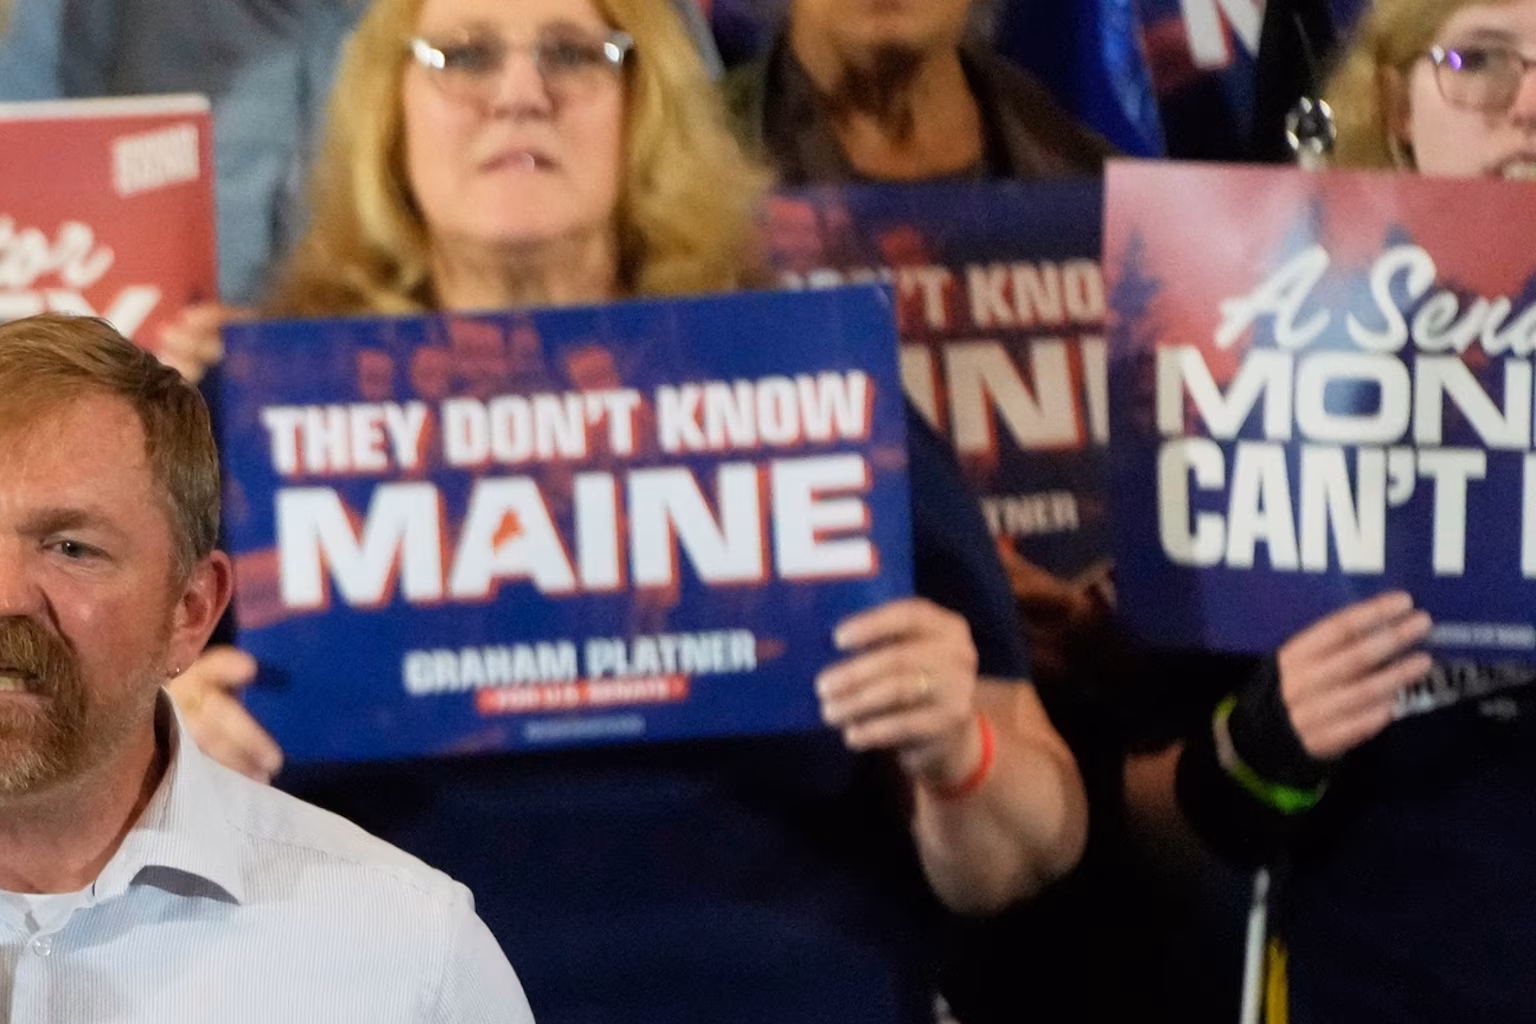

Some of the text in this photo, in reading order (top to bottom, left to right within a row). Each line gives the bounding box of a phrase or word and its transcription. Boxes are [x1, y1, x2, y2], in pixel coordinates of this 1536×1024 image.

[1215, 244, 1331, 351] A
[265, 401, 427, 476] THEY
[441, 388, 640, 467] DON'T
[656, 369, 866, 453] KNOW
[275, 453, 874, 608] MAINE
[1157, 436, 1487, 578] CAN'T
[403, 628, 757, 696] GRAHAM PLATNER
